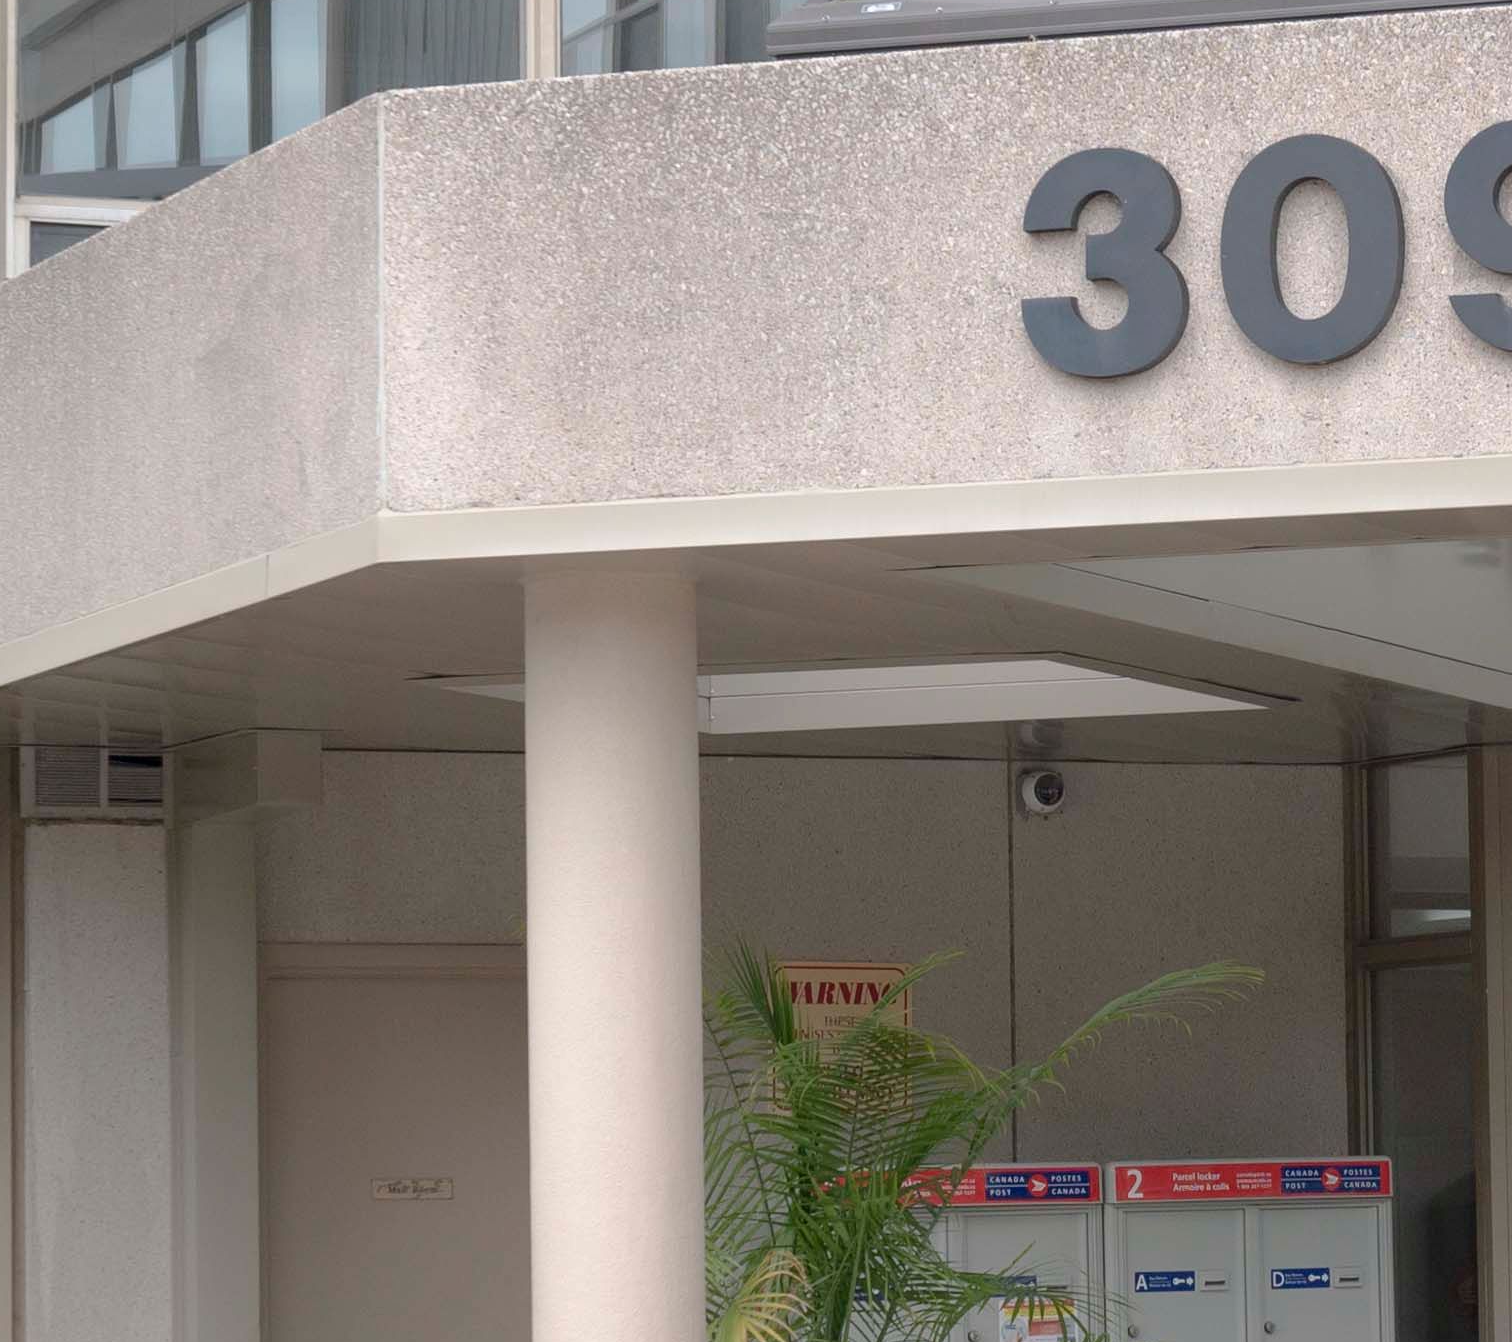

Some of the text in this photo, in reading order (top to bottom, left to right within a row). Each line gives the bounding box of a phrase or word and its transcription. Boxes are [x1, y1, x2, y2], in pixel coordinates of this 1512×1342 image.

[1285, 1169, 1320, 1178] CANADA
[1343, 1168, 1373, 1177] POSTES
[989, 1175, 1025, 1184] CANADA
[1051, 1174, 1082, 1183] POSTES
[1126, 1168, 1144, 1199] 2
[1285, 1182, 1307, 1190] POST
[1344, 1181, 1377, 1189] CANADA
[989, 1189, 1012, 1197] POST
[1051, 1187, 1087, 1196] CANADA
[1135, 1274, 1148, 1291] A
[1272, 1272, 1285, 1287] D
